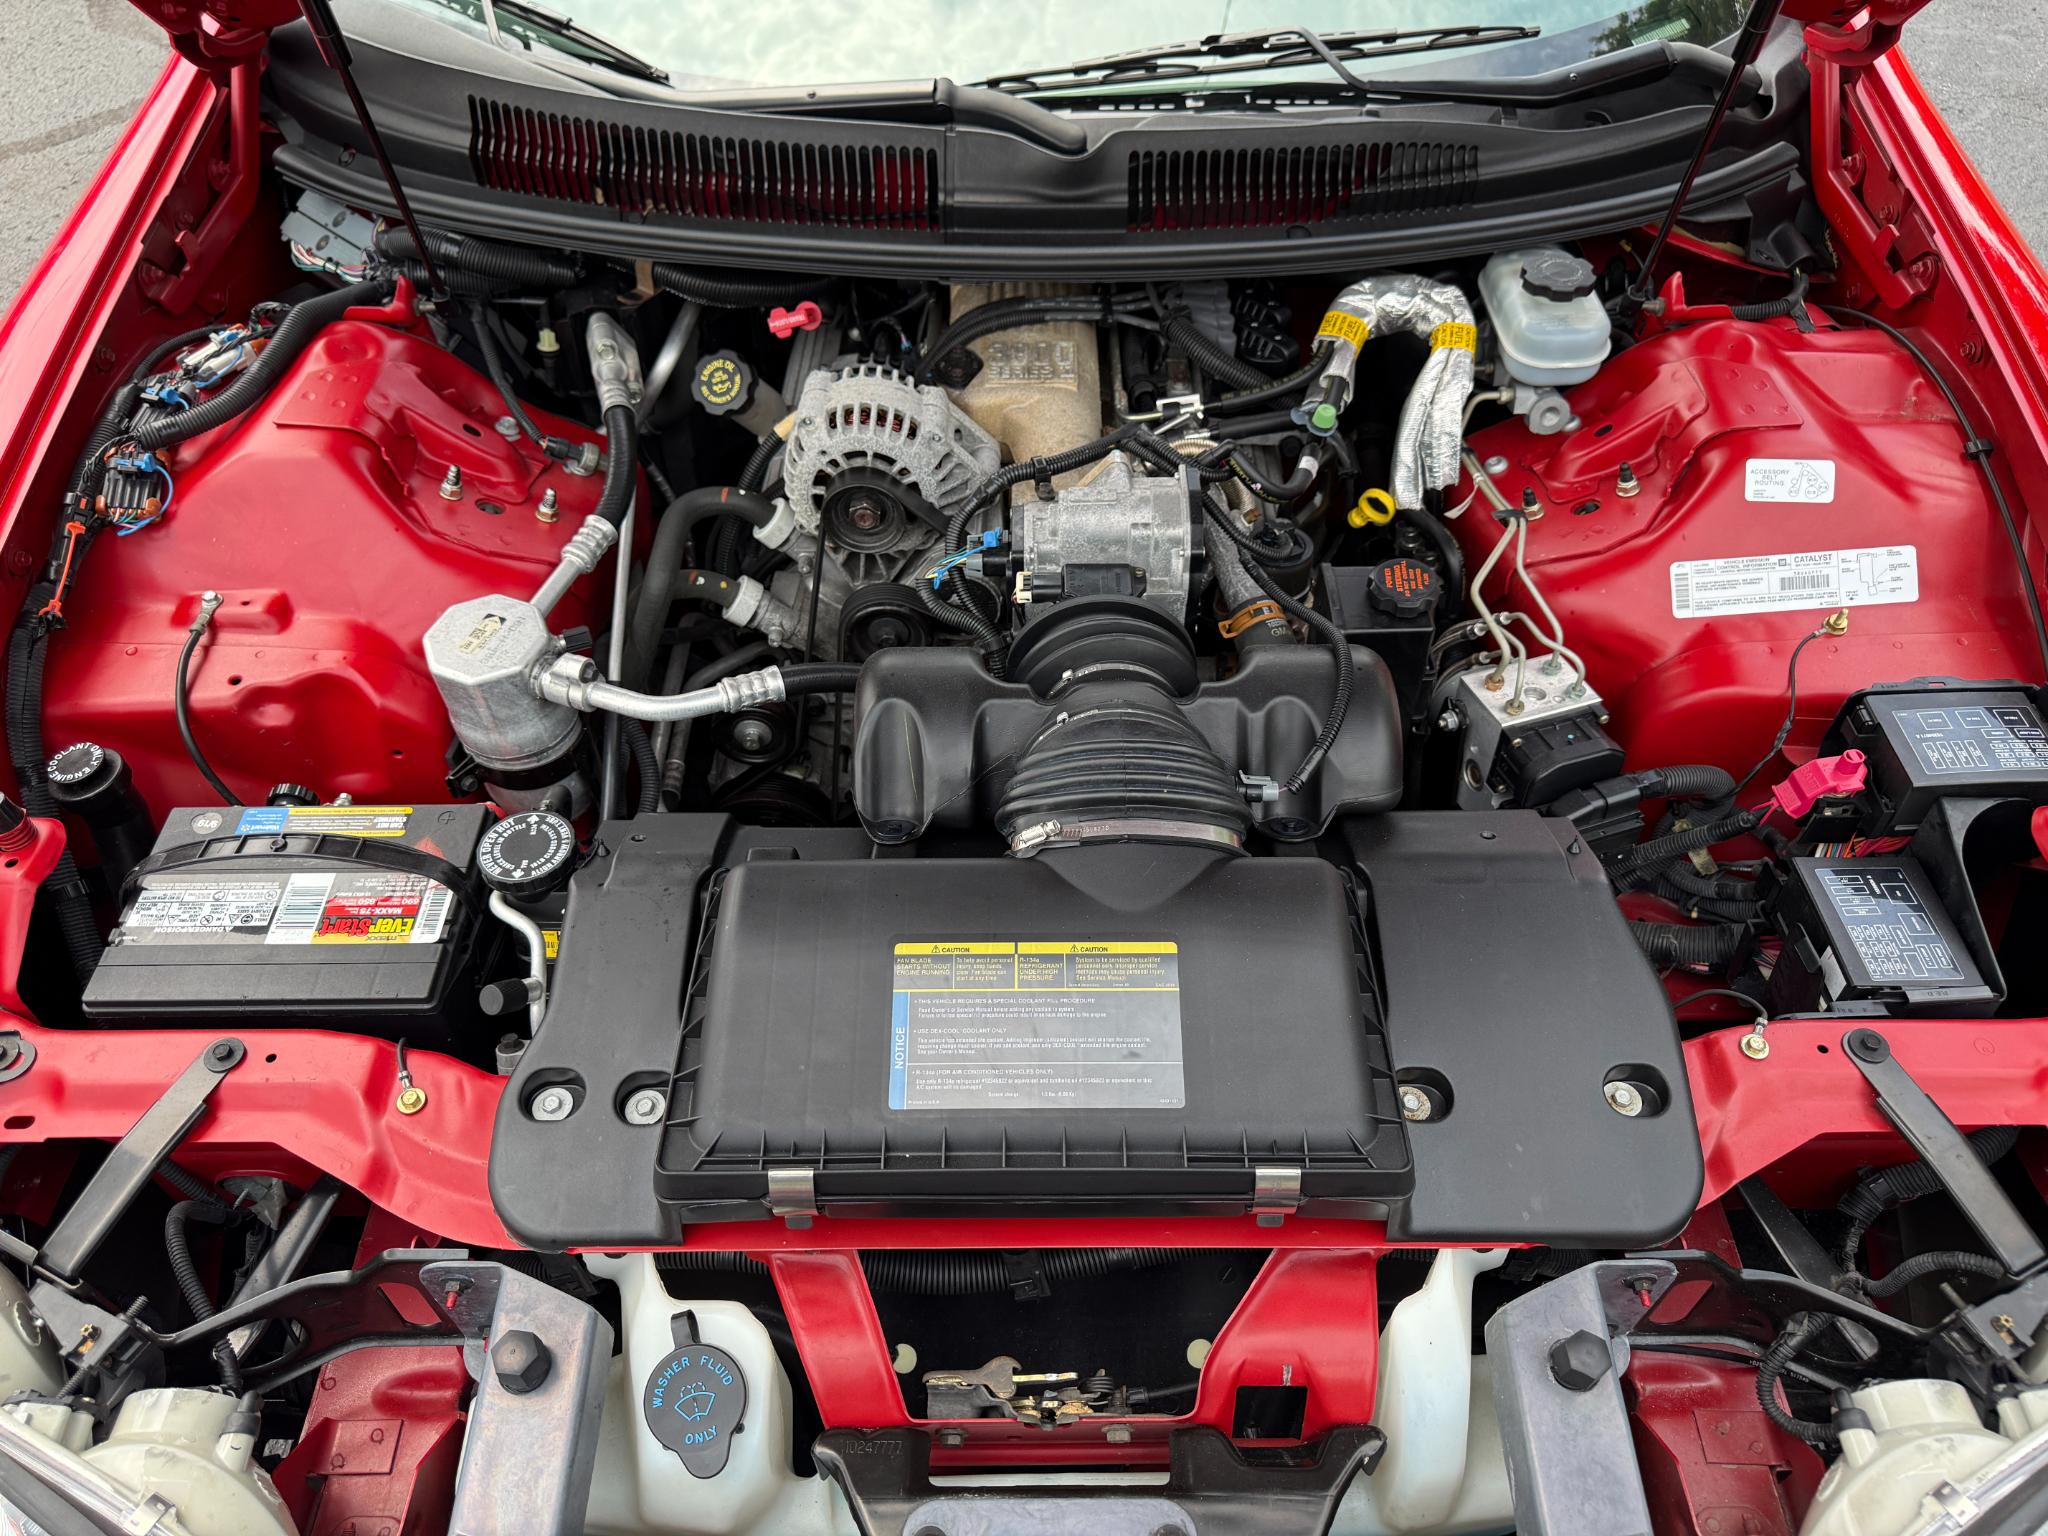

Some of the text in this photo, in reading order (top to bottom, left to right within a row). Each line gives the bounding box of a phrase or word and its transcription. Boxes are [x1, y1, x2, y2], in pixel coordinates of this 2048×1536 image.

[988, 365, 1053, 379] SERIES
[1794, 553, 1833, 563] CATALYST
[1384, 567, 1393, 589] POWER
[1393, 564, 1403, 592] STEERING
[48, 742, 104, 772] COOLANT ONLY
[49, 766, 92, 782] ENGINE
[197, 819, 219, 829] 9/19
[250, 824, 280, 832] Walmart
[481, 818, 516, 876] NEVER OPEN HOT
[493, 823, 527, 870] CHECK LEVEL IN BOTTLE
[531, 862, 554, 877] ALIGN
[359, 907, 404, 915] MAXX-75
[400, 897, 420, 905] 690
[317, 916, 415, 939] EverStart
[894, 1027, 906, 1069] NOTICE
[652, 1355, 733, 1409] WASHER FLUID
[685, 1425, 718, 1445] ONLY
